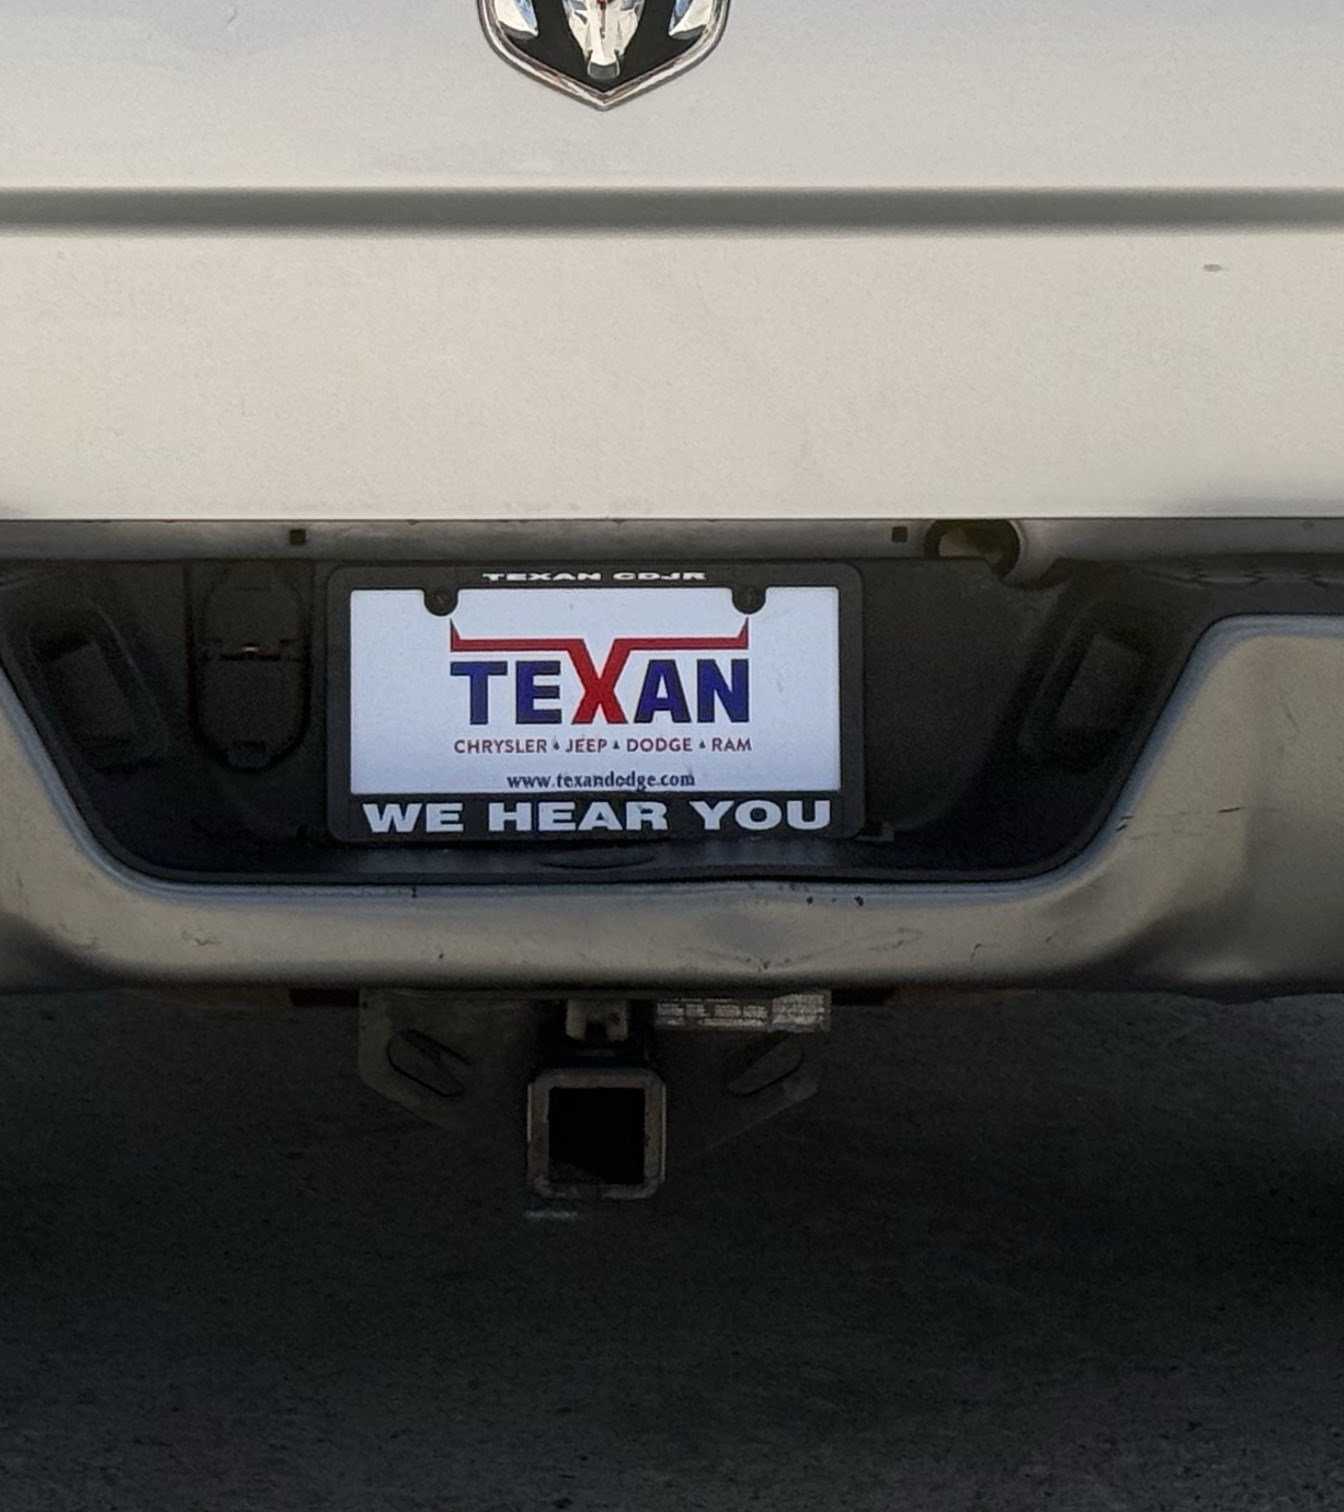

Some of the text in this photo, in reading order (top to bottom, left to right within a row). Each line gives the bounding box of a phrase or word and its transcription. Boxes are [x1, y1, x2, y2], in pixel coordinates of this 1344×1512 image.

[481, 571, 707, 582] TEXAN CDJR
[449, 638, 750, 726] TEXAN
[453, 737, 753, 754] CHRYSLER JEEP DODGE RAM
[506, 770, 696, 791] www.texandodge.com
[362, 799, 832, 833] WE HEAR YOU
